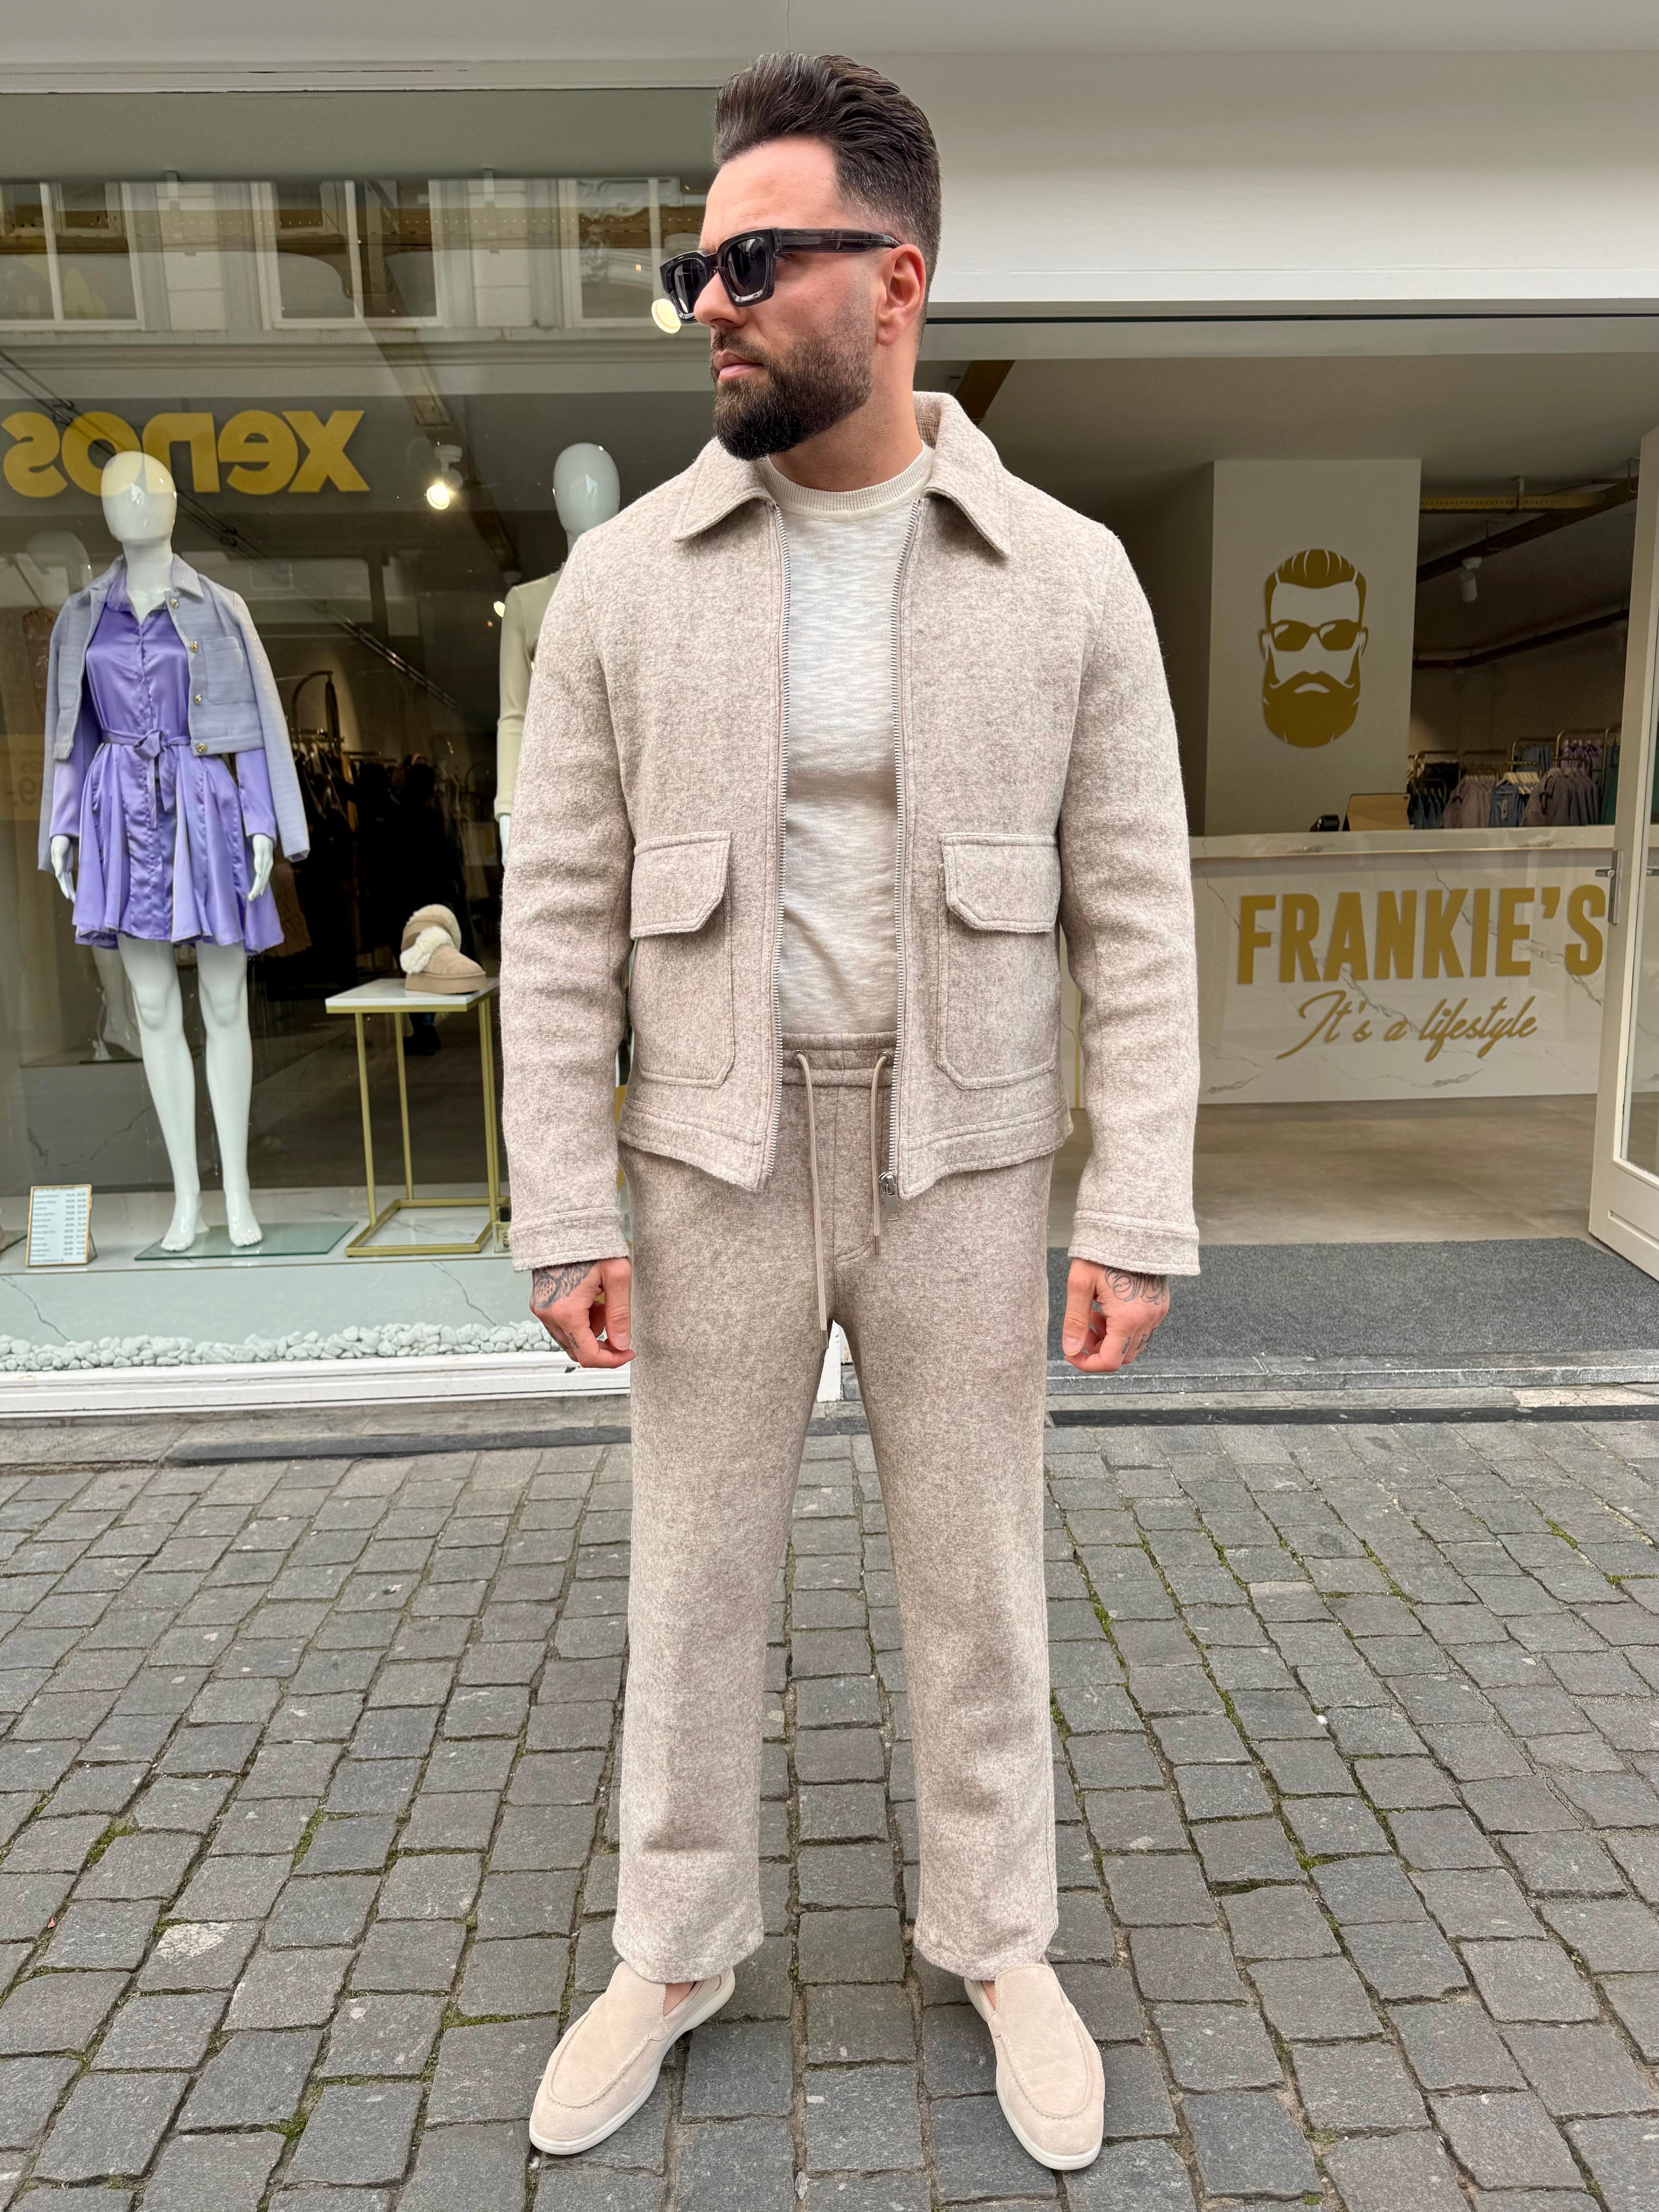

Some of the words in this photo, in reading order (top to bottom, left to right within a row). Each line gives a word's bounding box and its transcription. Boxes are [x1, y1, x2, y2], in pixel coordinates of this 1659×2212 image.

[1237, 884, 1605, 984] FRANKIE'S
[1275, 990, 1372, 1059] It's
[1384, 1020, 1407, 1041] a
[1418, 995, 1537, 1062] lifestyle
